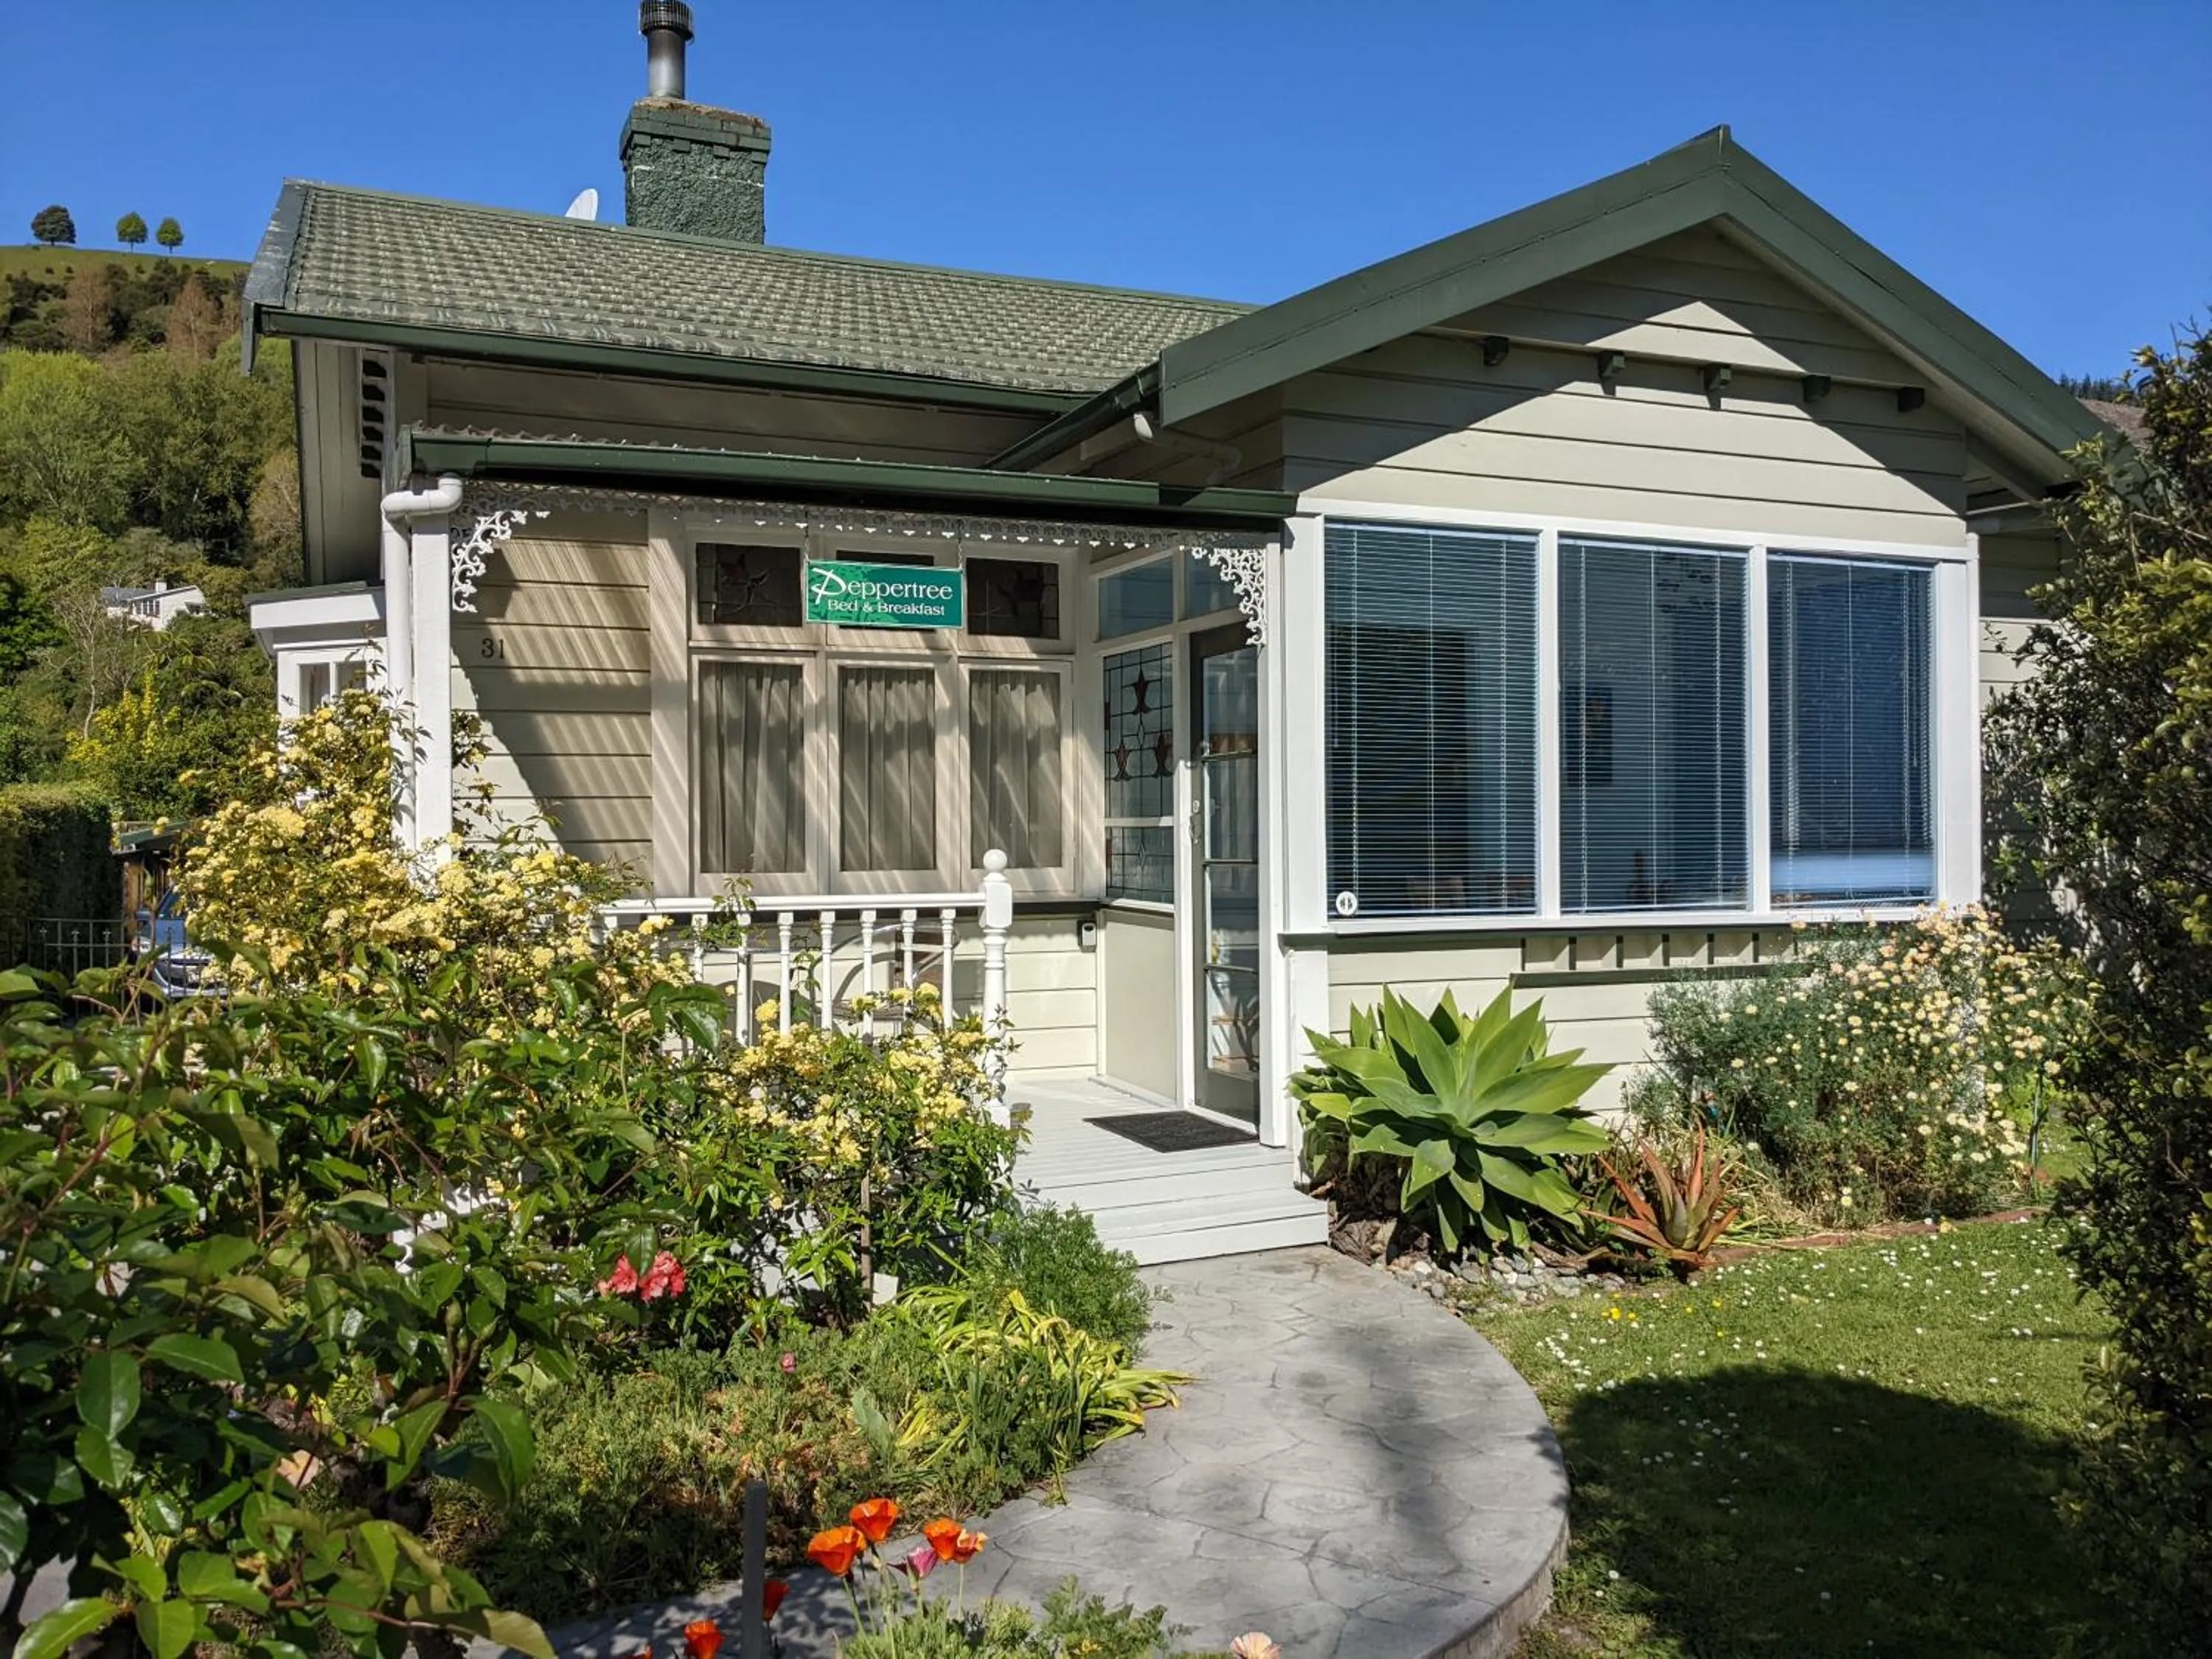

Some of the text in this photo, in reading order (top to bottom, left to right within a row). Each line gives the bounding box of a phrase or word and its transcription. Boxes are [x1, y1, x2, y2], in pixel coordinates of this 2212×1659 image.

[811, 567, 953, 605] Peppertree
[827, 599, 945, 616] Bed & Breakfast
[481, 638, 504, 659] 31
